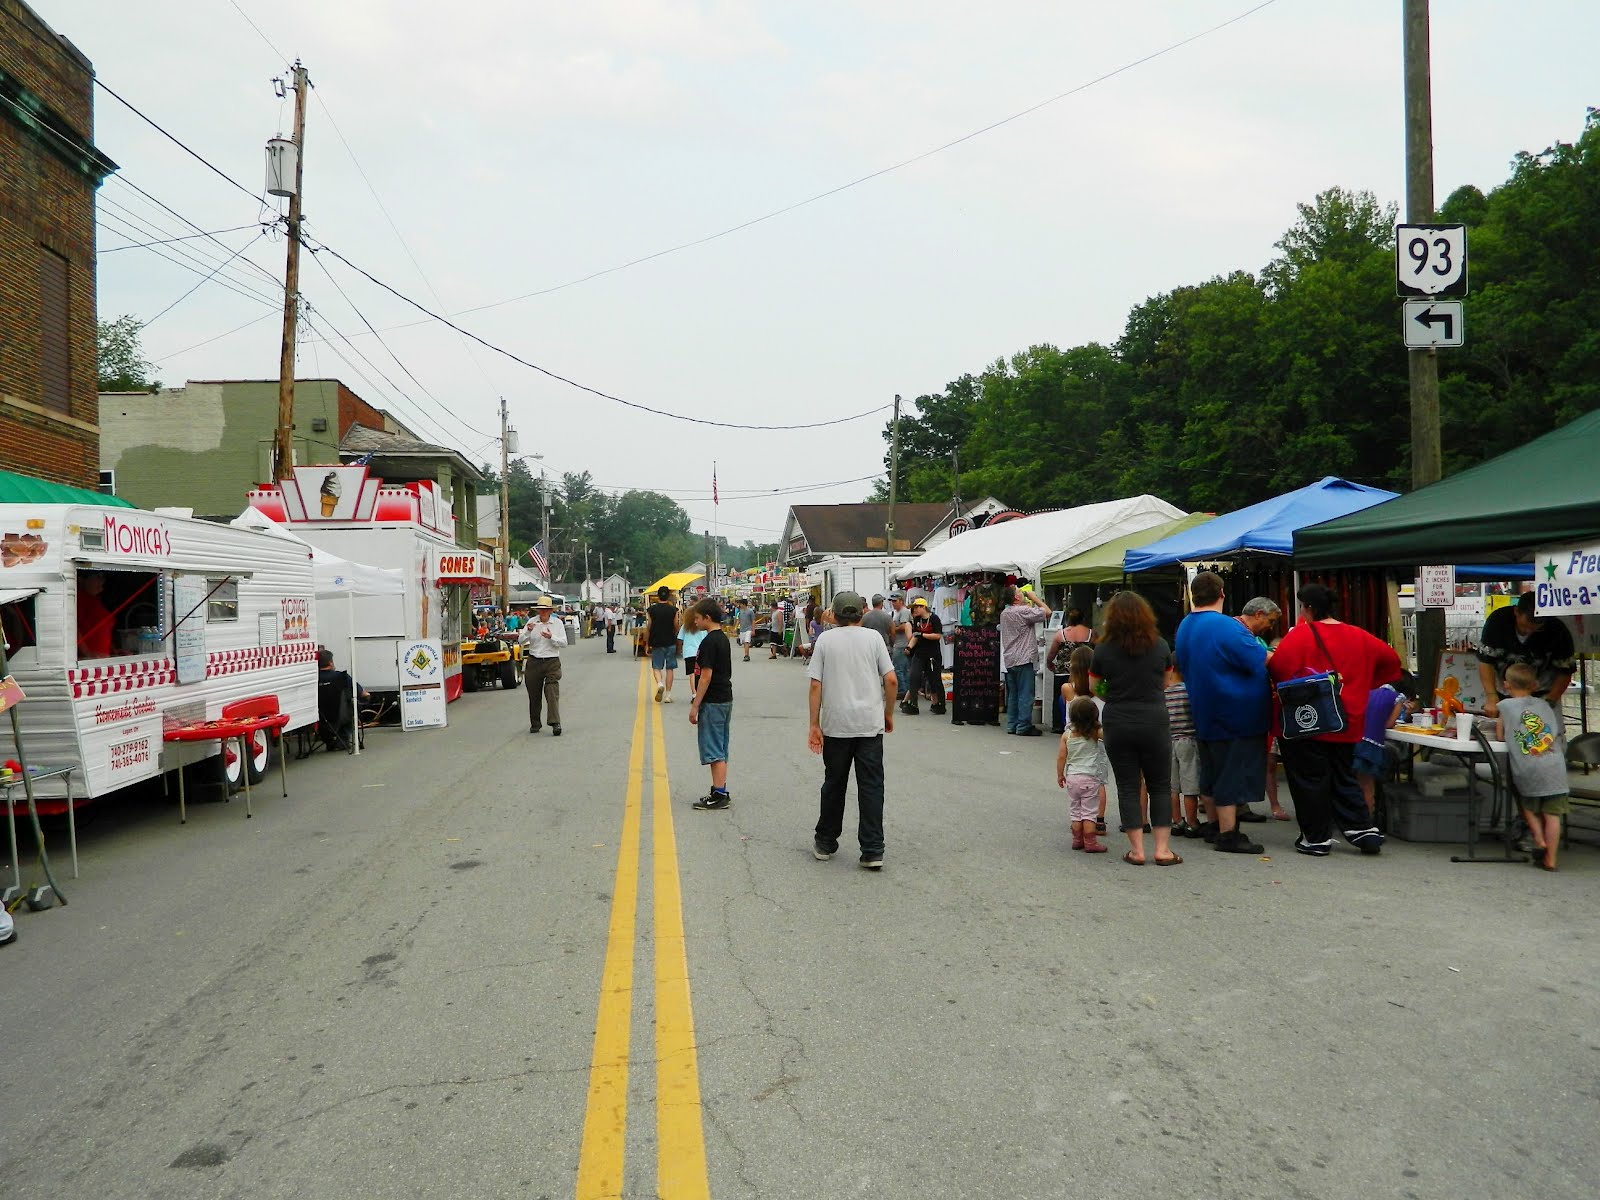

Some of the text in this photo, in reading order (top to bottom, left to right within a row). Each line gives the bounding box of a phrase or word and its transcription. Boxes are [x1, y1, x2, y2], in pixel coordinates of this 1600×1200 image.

[1408, 237, 1452, 276] 93
[439, 556, 475, 574] CONES
[1537, 583, 1600, 608] Give-a-
[965, 642, 983, 650] Photos
[406, 667, 421, 679] LODGE
[95, 700, 132, 724] Homemade
